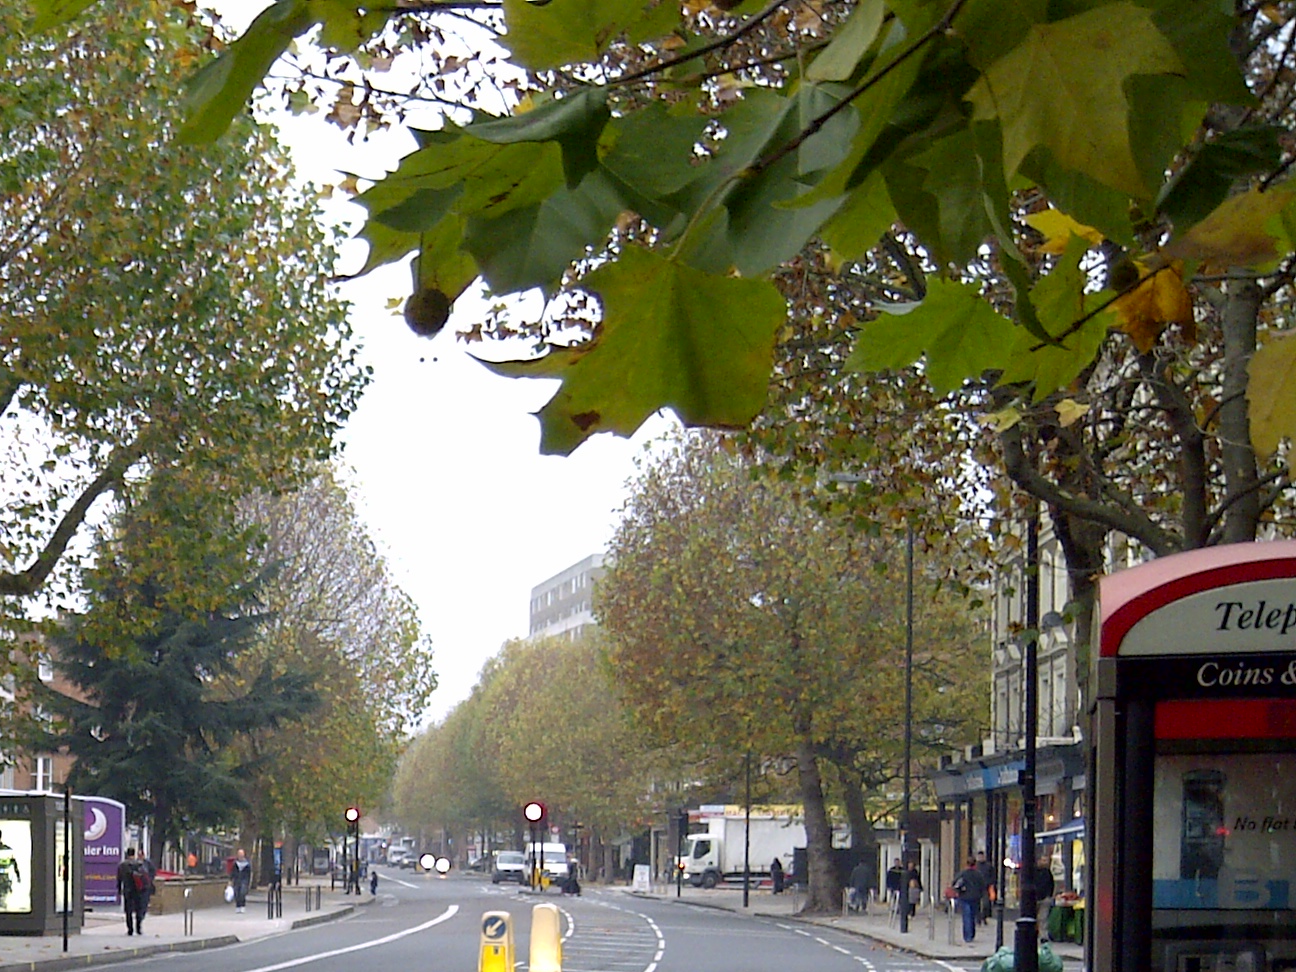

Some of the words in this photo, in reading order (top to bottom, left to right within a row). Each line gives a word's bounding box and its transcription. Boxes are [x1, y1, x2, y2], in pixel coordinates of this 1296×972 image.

[1197, 662, 1274, 687] Coins
[1234, 817, 1257, 831] No
[103, 845, 120, 856] Inn
